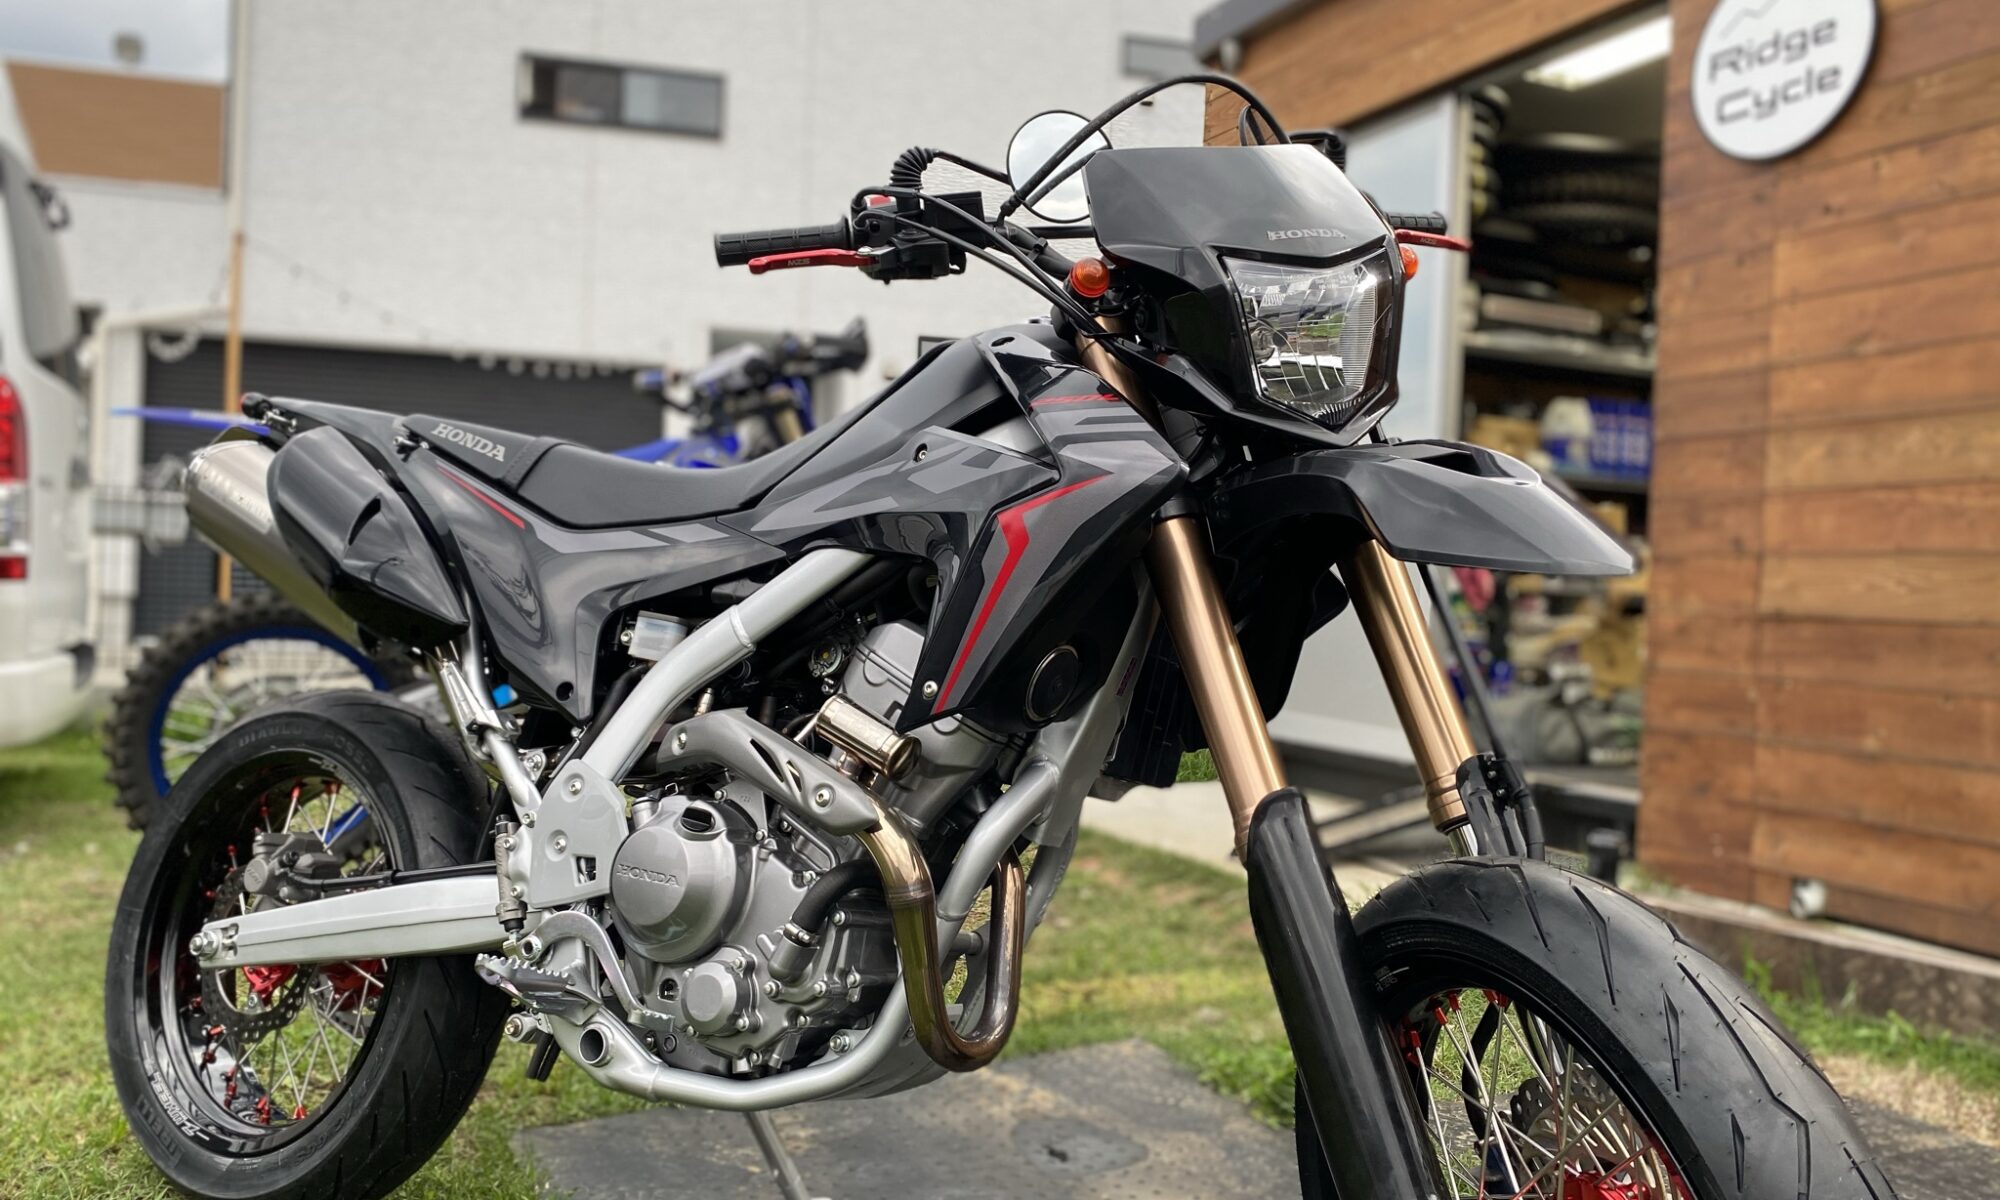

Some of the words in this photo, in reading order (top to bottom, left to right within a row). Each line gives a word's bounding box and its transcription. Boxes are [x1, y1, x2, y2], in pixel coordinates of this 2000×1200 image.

[1709, 18, 1837, 84] Ridge
[1715, 65, 1842, 126] Cycle
[1267, 228, 1348, 241] HONDA
[431, 423, 506, 462] HONDA
[616, 863, 681, 888] HONDA
